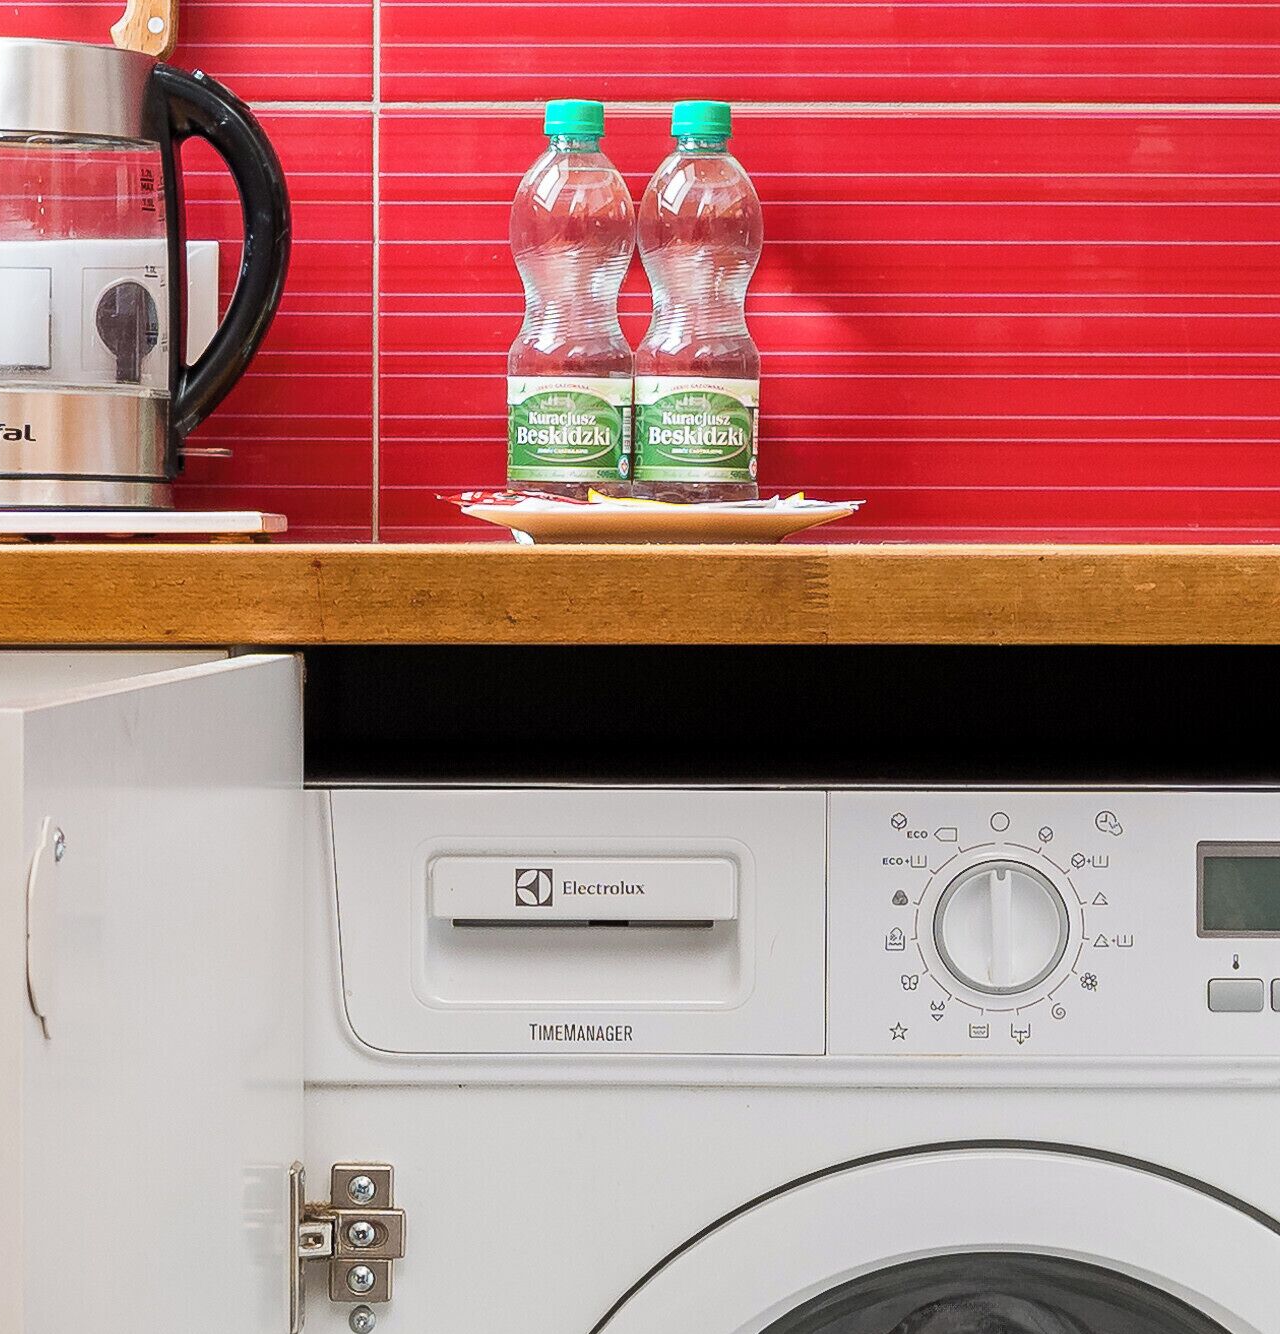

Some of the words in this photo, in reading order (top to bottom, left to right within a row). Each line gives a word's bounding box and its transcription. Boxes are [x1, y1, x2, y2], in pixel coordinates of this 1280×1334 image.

[528, 412, 597, 427] Kuracjusz
[662, 412, 731, 427] Kuracjusz
[517, 426, 611, 446] Beskidzki
[648, 426, 744, 446] Beskidzki
[906, 830, 928, 839] ECO
[563, 881, 645, 895] Electrolux
